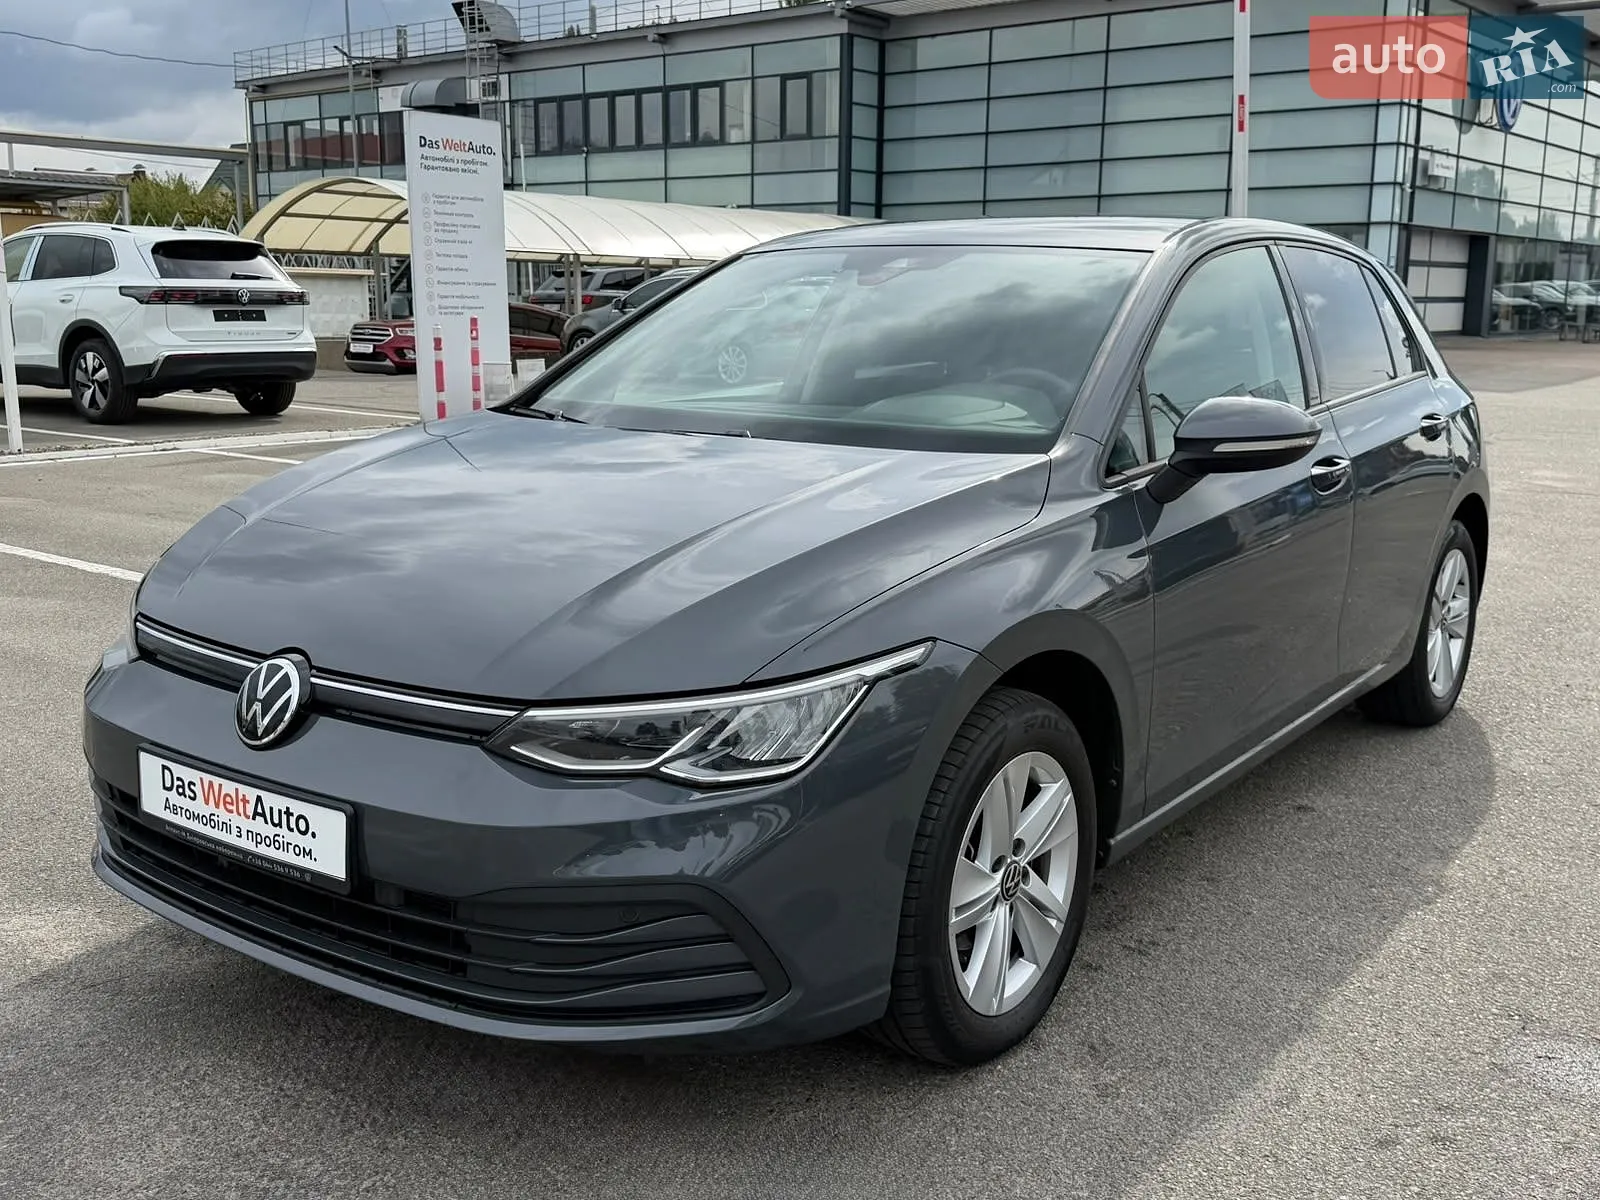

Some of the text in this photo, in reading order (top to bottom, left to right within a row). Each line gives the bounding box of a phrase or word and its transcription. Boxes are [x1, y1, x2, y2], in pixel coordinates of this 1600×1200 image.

[419, 135, 496, 156] Das WeltAuto.
[420, 153, 455, 164] Автомобілі
[420, 162, 460, 174] Гарантовано
[161, 763, 318, 840] Das WeltAuto.
[163, 797, 232, 836] Автомобілі
[235, 824, 243, 839] з
[246, 828, 318, 863] пробігом.
